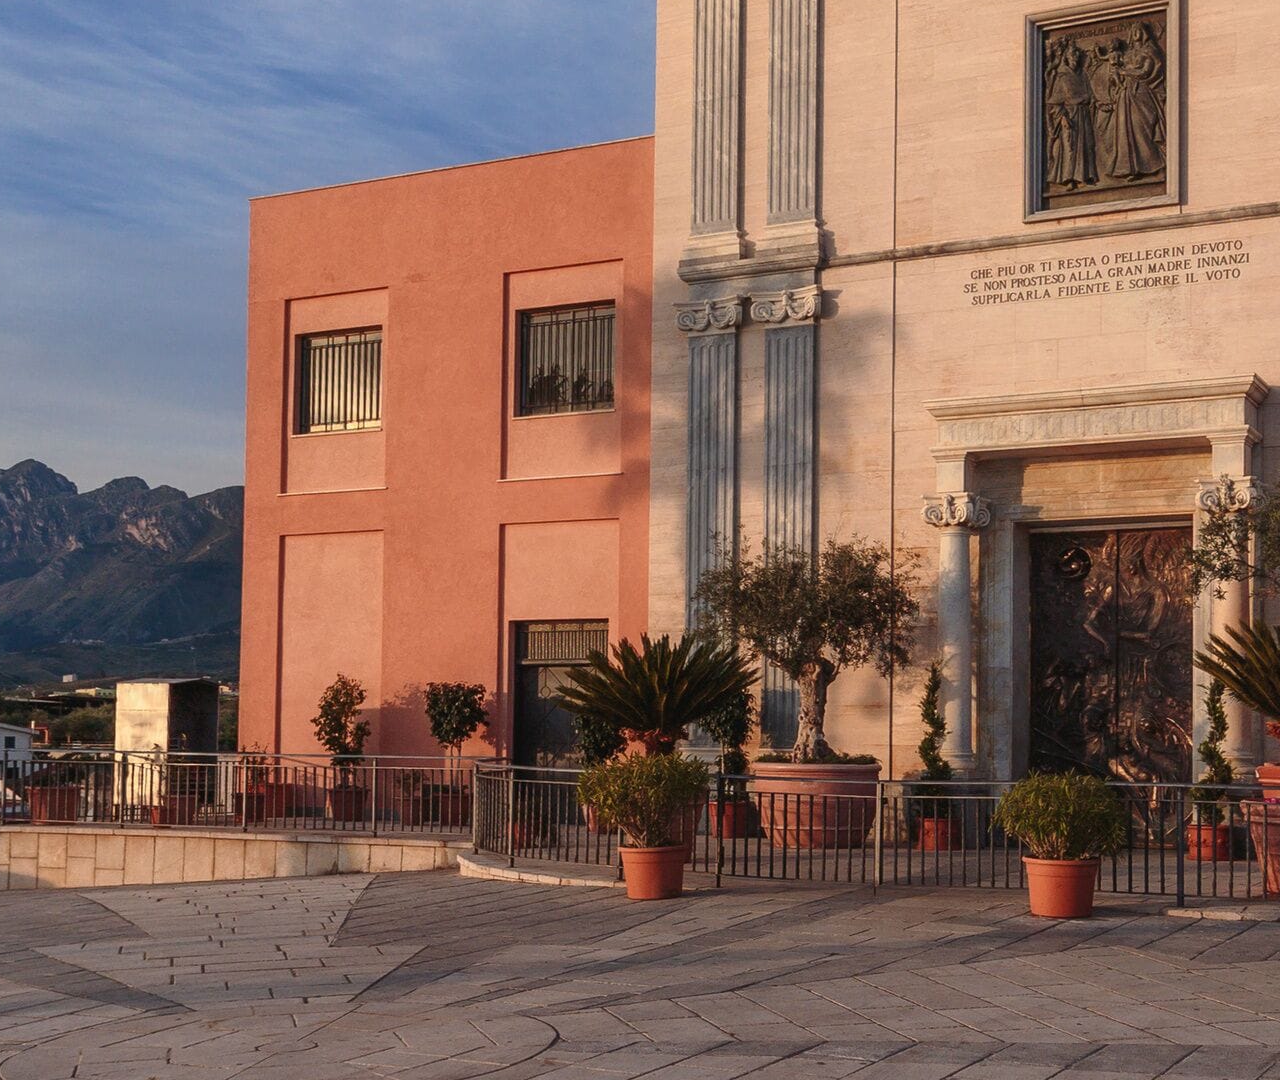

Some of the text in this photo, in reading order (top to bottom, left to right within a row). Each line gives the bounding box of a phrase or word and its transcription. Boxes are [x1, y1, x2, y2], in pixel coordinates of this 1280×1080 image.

[963, 252, 1250, 294] SE NON PROSTESO ALLA GRAN MADRE INNANZI
[970, 239, 1243, 280] CHE PIU OR TI RESTA O PELLEGRIN DEVOTO
[971, 268, 1241, 306] SUPPLICARLA FIDENTE E SCIORRE IL VOTO
